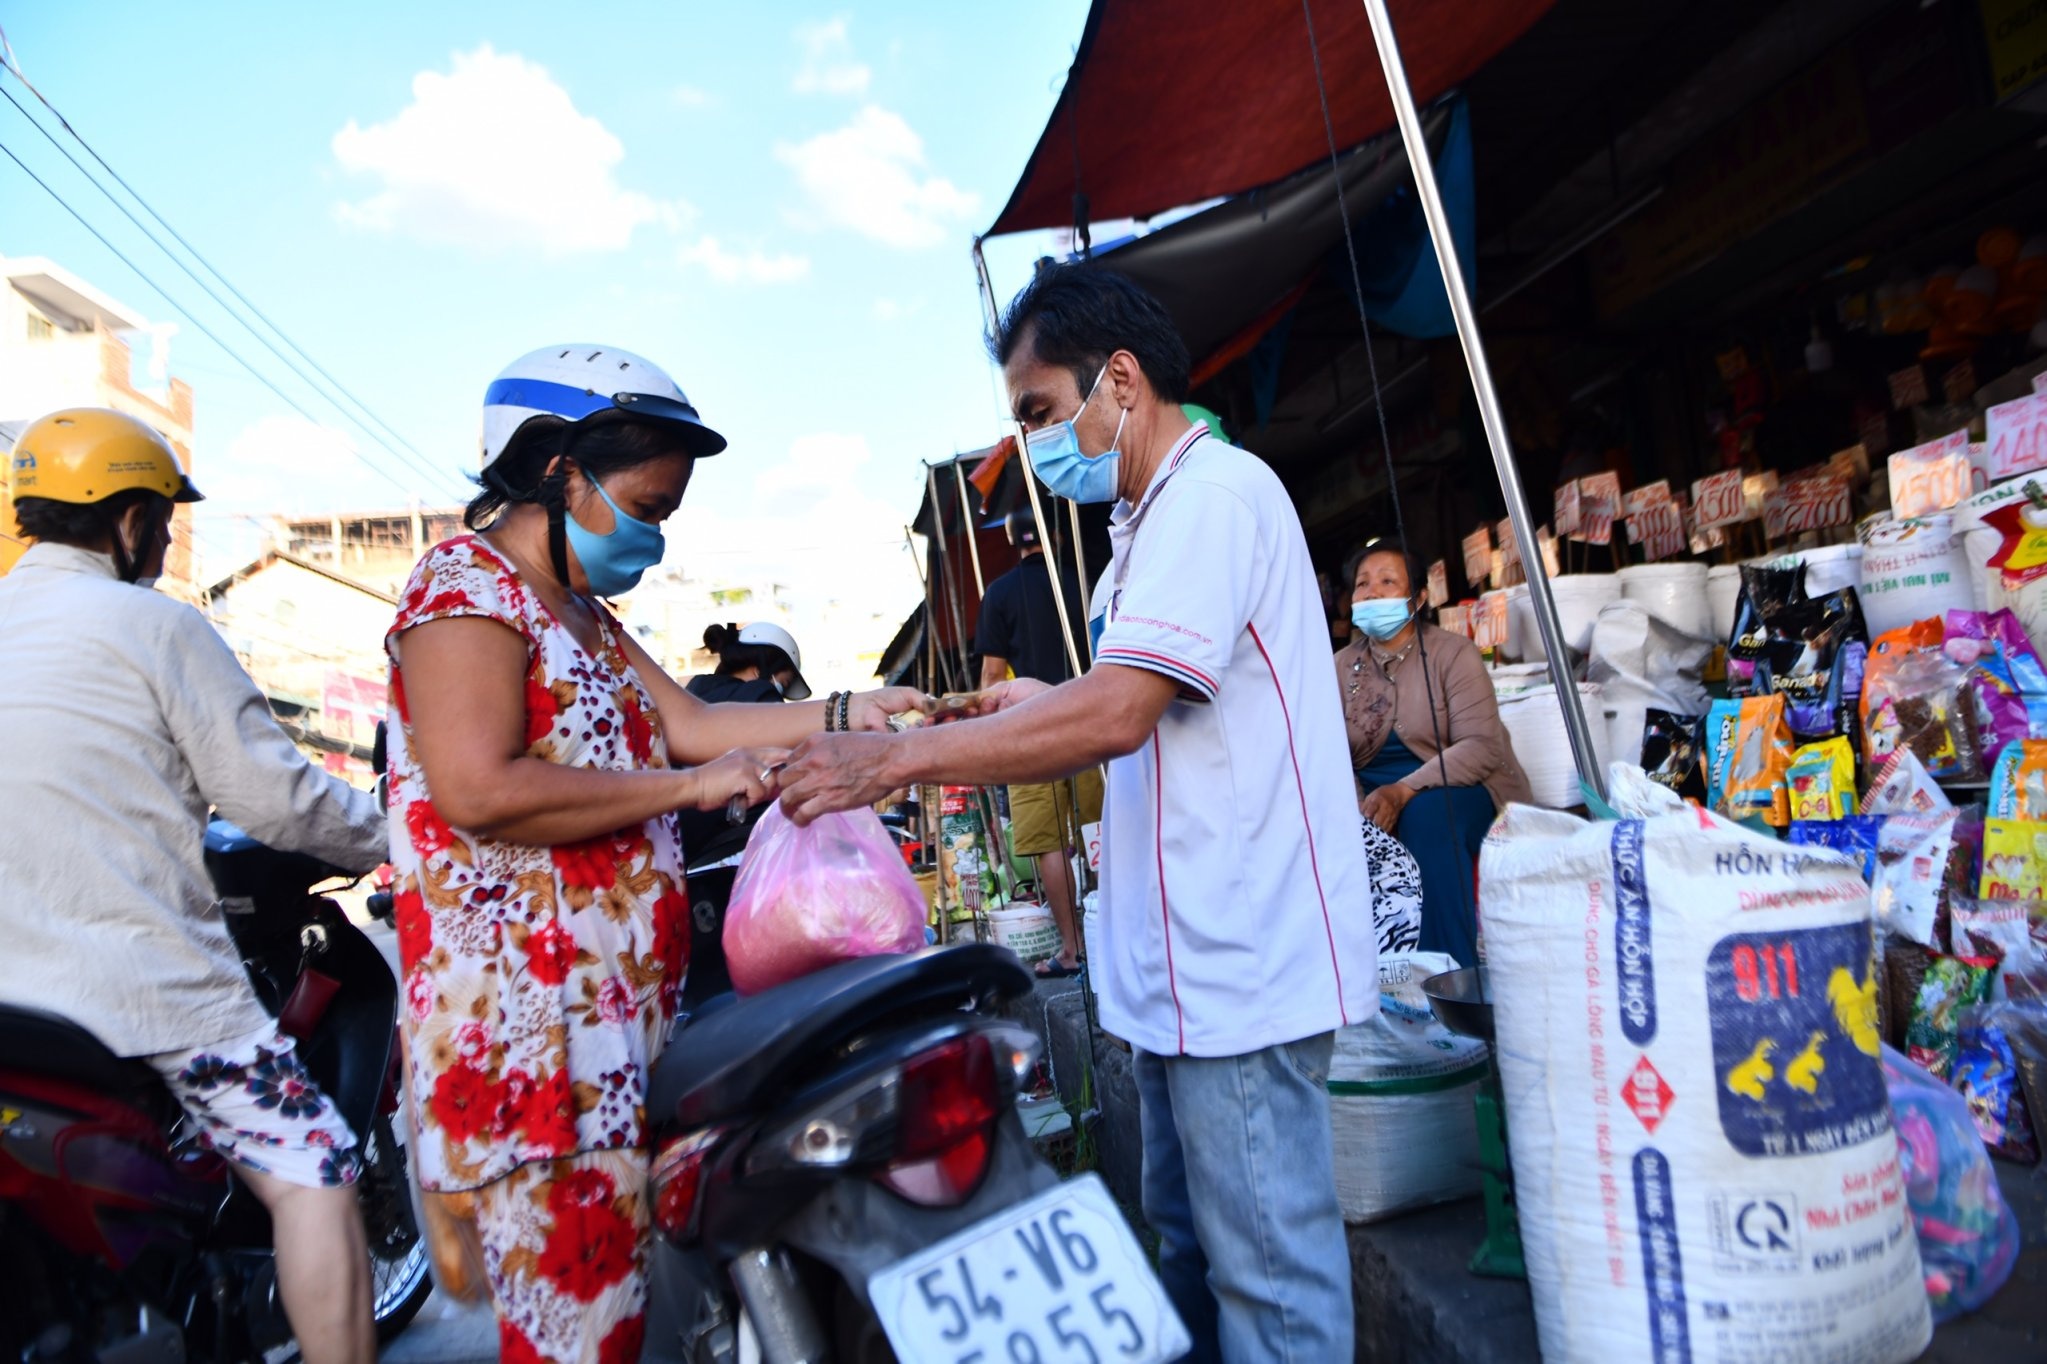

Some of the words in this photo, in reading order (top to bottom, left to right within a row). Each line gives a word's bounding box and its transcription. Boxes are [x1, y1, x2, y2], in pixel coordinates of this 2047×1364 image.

[1617, 822, 1639, 882] THỨC
[1715, 843, 1773, 876] HỖN
[1621, 887, 1644, 921] ĂN
[1585, 928, 1600, 963] CHO
[1623, 925, 1651, 976] HỖN
[1732, 940, 1799, 1003] 911
[1588, 994, 1606, 1039] LÔNG
[1624, 980, 1649, 1028] HỢP
[1633, 1069, 1660, 1118] 911
[917, 1208, 1098, 1344] 54-V6
